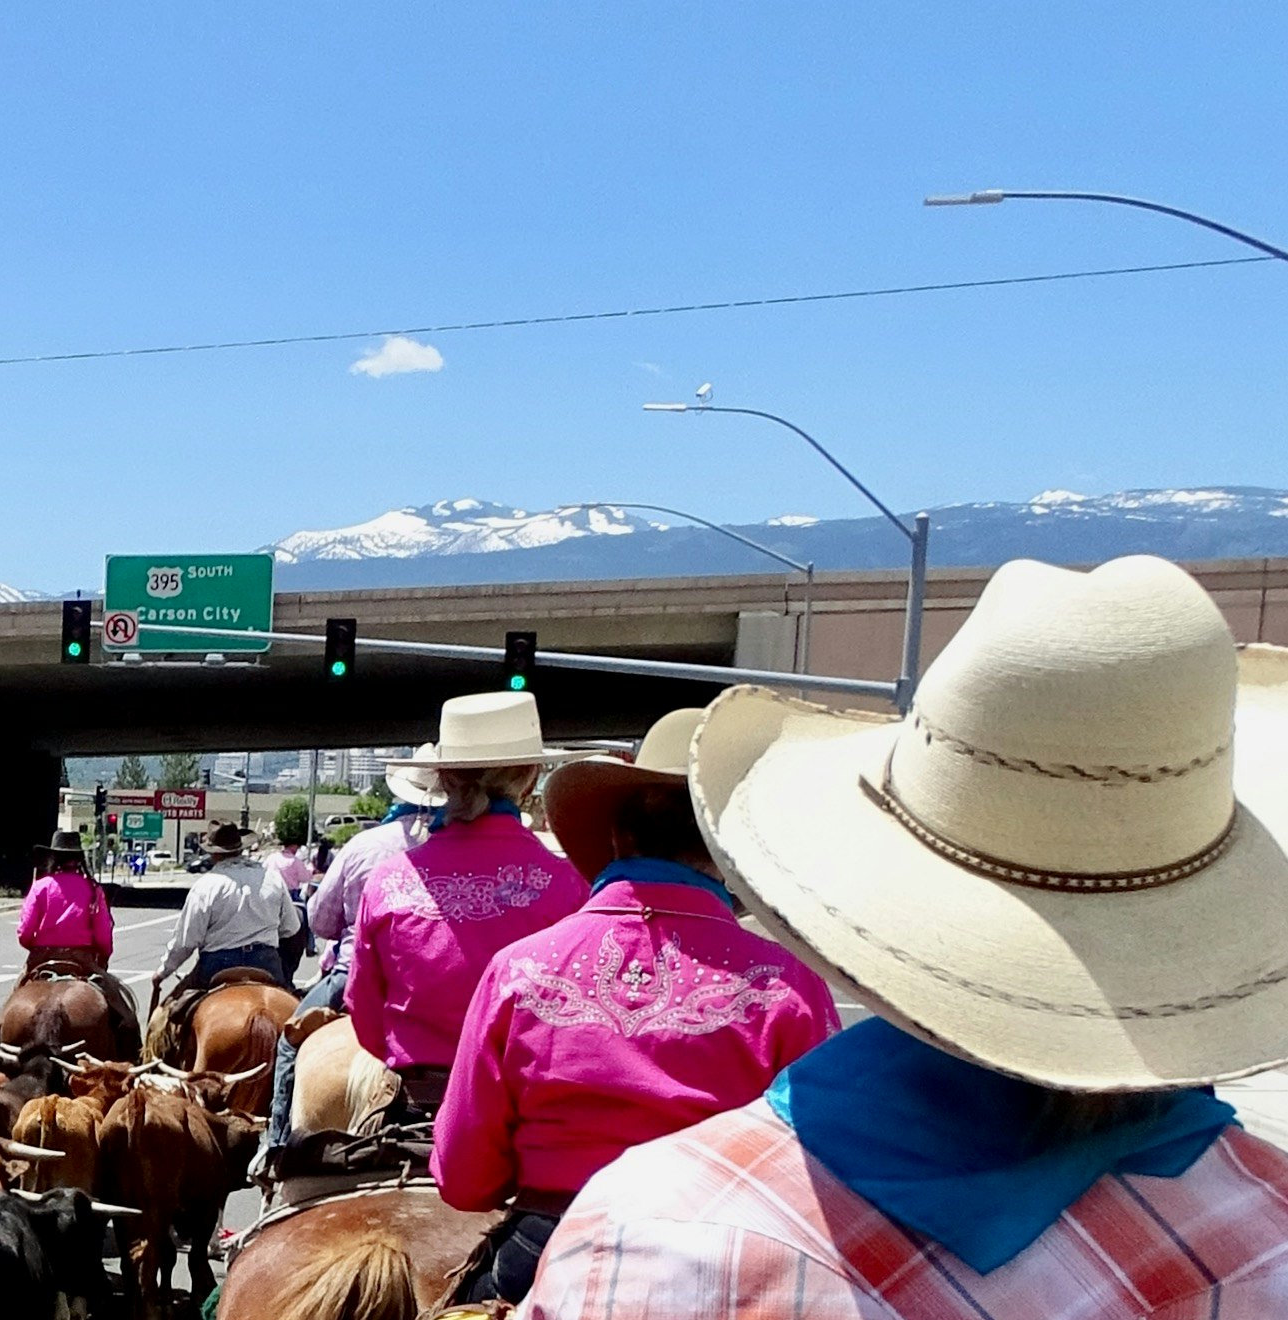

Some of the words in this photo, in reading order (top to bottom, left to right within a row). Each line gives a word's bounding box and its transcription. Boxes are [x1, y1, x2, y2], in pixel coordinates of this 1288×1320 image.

[150, 573, 180, 591] 395
[187, 565, 233, 579] SOUTH
[137, 607, 196, 621] Carson
[203, 607, 241, 623] City
[178, 809, 203, 818] PARTS
